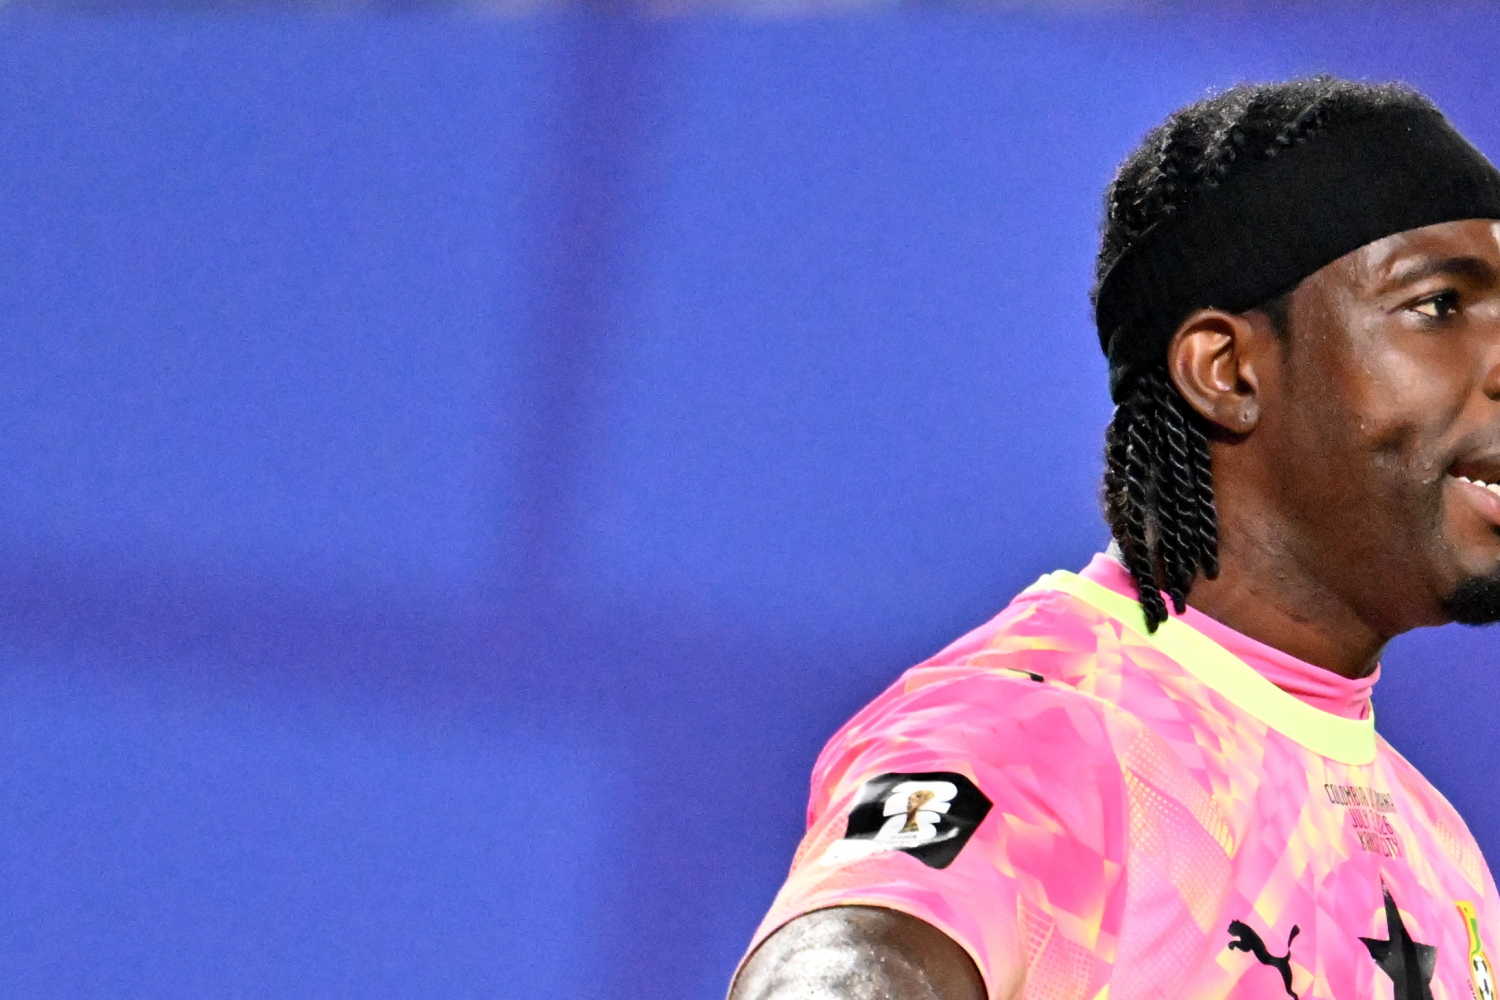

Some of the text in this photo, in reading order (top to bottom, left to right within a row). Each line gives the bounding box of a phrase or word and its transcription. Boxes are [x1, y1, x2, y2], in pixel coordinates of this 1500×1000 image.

[1324, 783, 1369, 807] COLOMBIA
[1349, 808, 1370, 829] JULY
[1380, 836, 1402, 858] CITY
